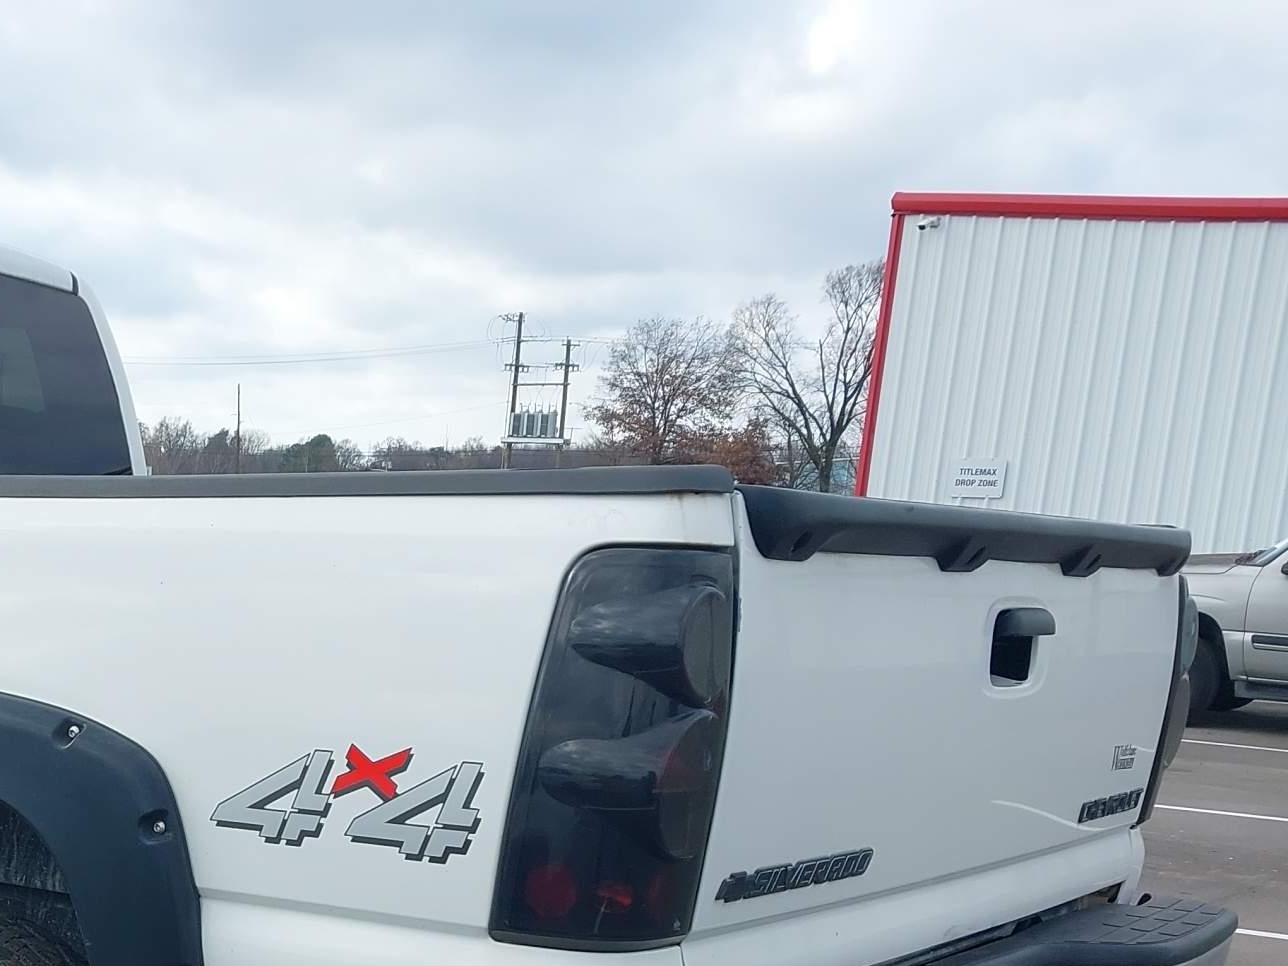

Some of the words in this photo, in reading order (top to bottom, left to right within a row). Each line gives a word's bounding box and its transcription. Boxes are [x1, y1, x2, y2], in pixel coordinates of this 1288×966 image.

[960, 468, 998, 476] TITLEMAX
[954, 478, 977, 487] DROP
[977, 479, 999, 488] ZONE
[744, 847, 874, 899] SILVERADO
